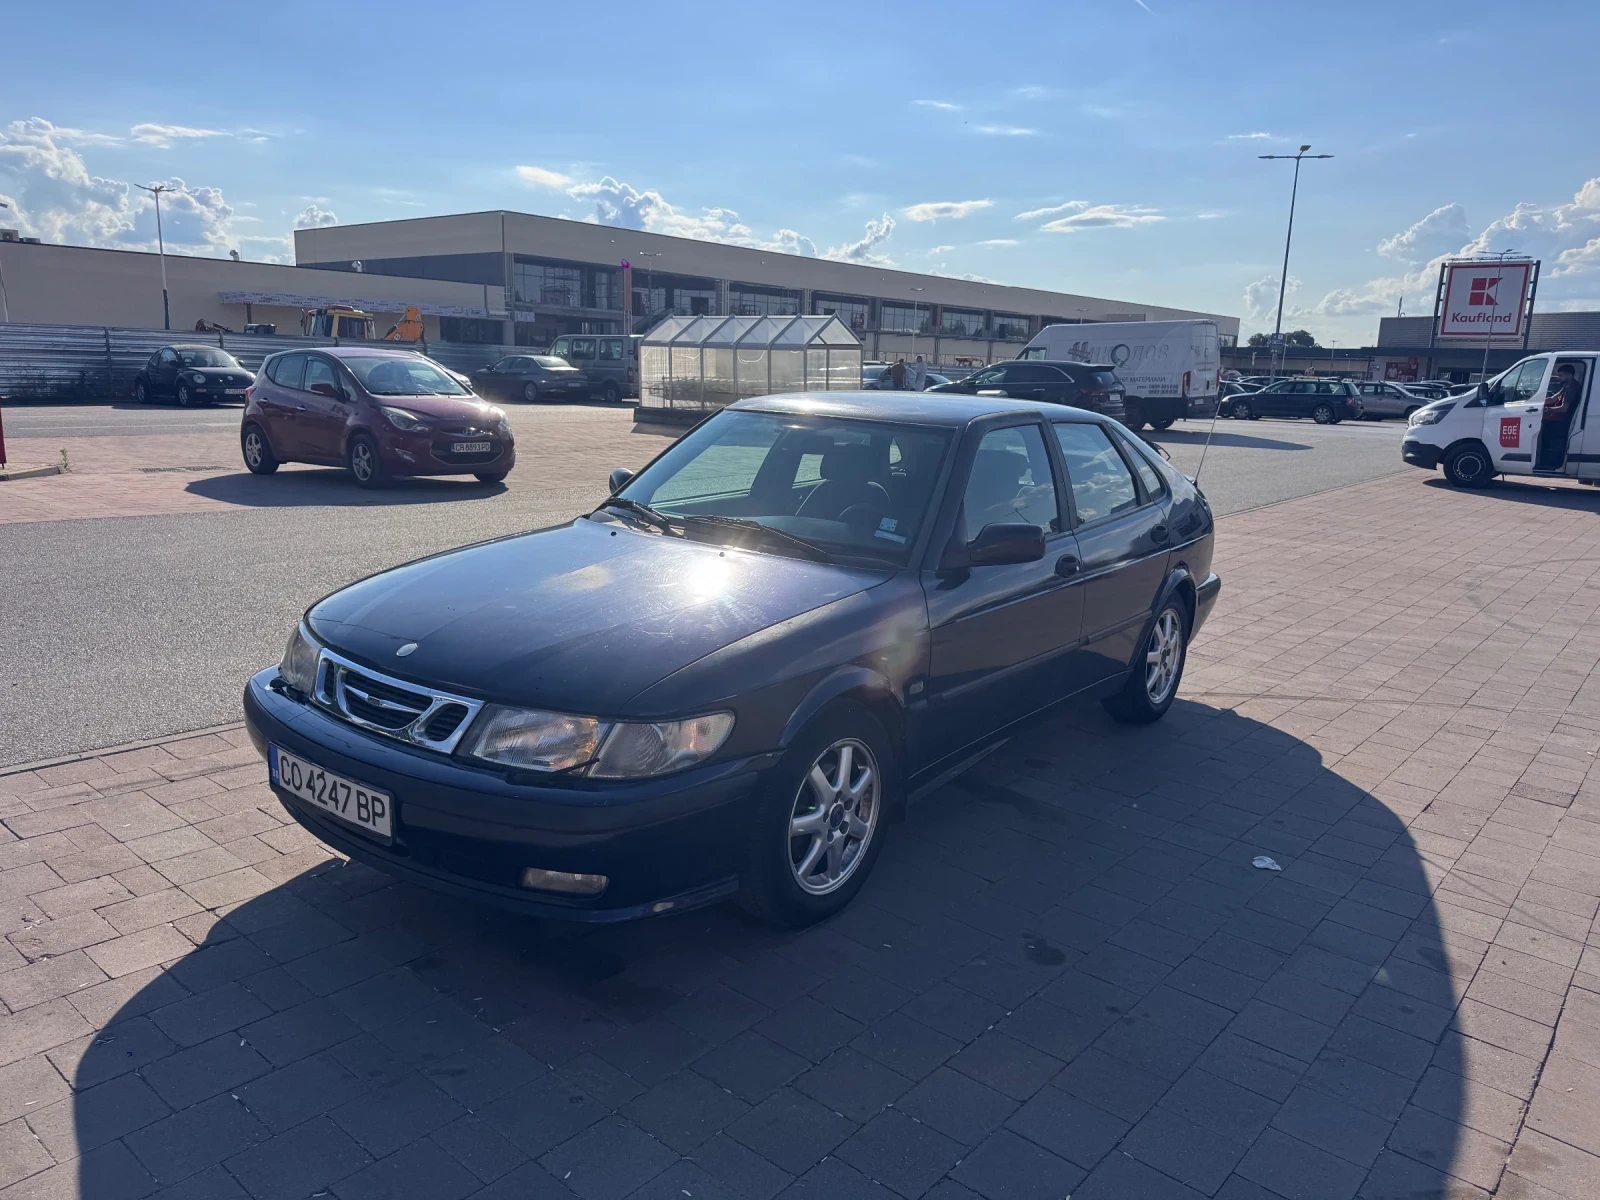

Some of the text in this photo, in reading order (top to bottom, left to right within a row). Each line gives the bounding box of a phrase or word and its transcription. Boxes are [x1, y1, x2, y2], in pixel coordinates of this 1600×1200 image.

[1451, 312, 1512, 323] Kaufland
[1502, 425, 1518, 435] EGE
[280, 755, 386, 827] CO 4247 BP
